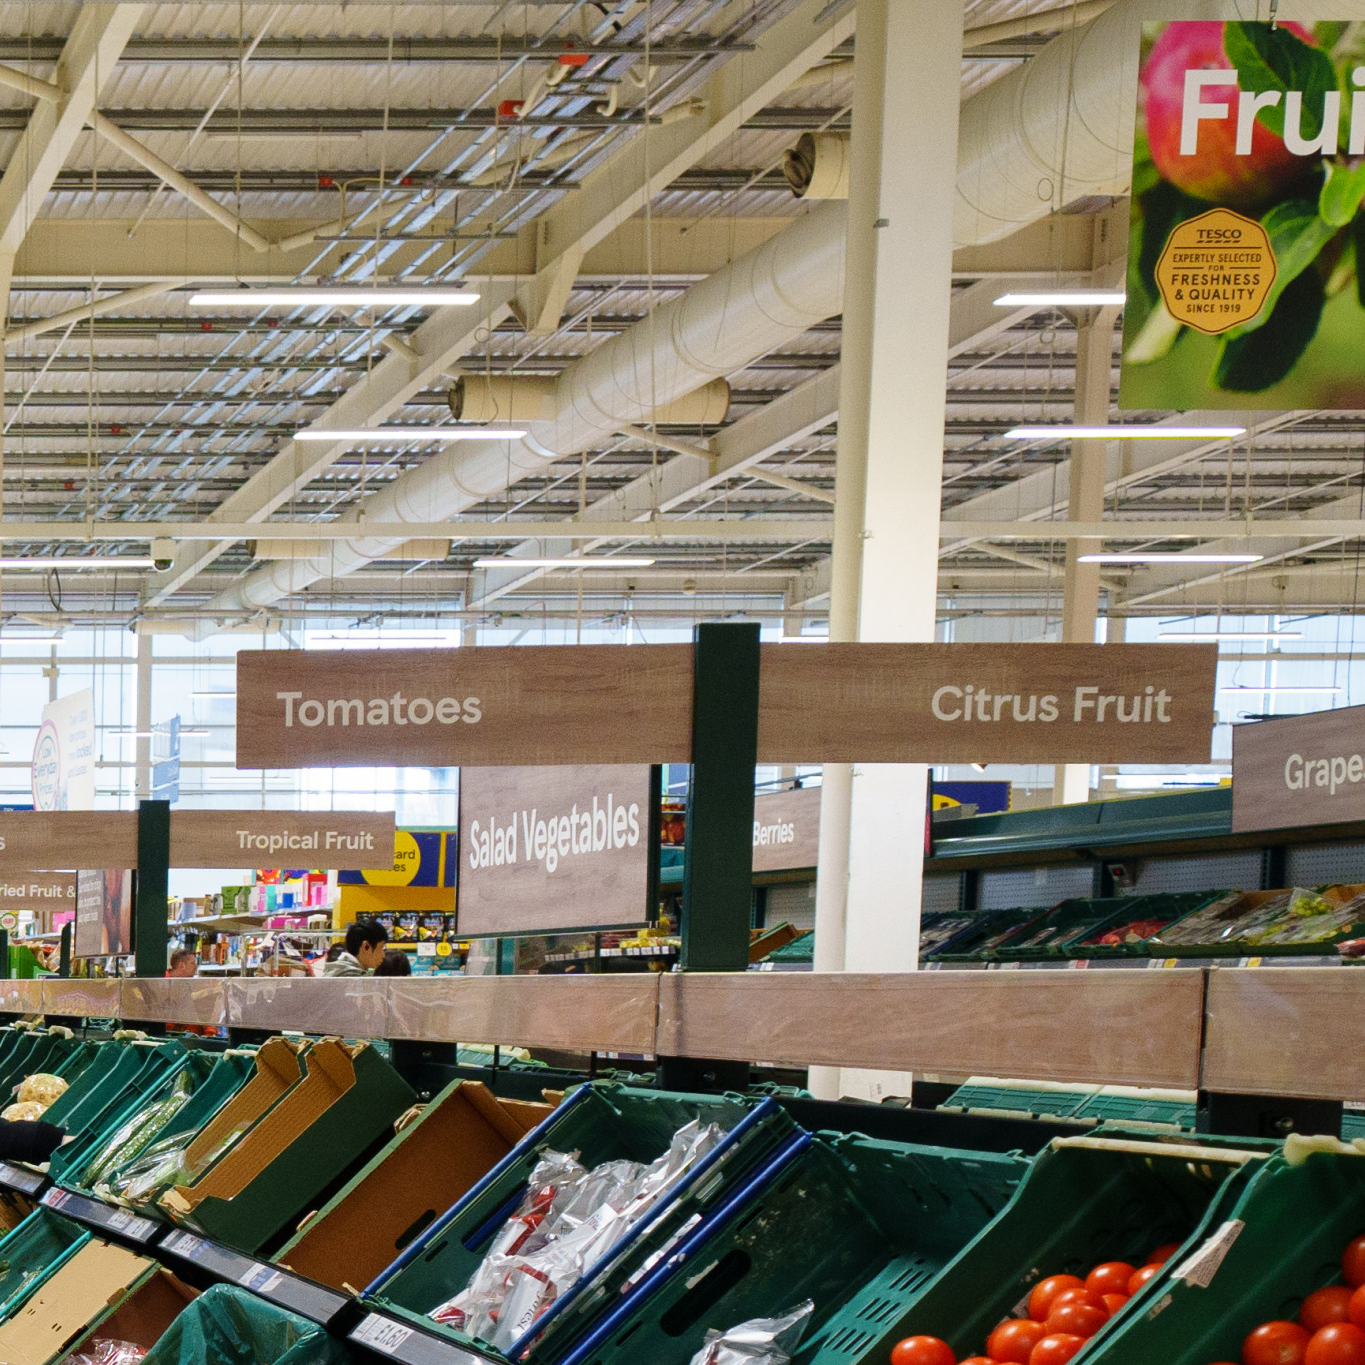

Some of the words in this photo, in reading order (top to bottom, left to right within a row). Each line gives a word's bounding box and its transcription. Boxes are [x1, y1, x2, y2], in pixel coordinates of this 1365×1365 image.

[1197, 229, 1242, 239] TESCO
[1172, 253, 1215, 263] EXPERTLY
[1218, 253, 1262, 263] SELECTED
[1171, 274, 1260, 286] FRESHNESS
[1175, 289, 1184, 300] &
[1189, 289, 1255, 300] QUALITY
[1186, 304, 1215, 313] SINCE
[1219, 304, 1240, 313] 1919
[277, 691, 482, 727] Tomatoes
[931, 685, 1059, 723] Citrus
[1072, 685, 1173, 723] Fruit
[469, 812, 518, 870] Salad
[522, 793, 640, 873] Vegetables
[752, 818, 795, 846] Berries
[235, 830, 318, 853] Tropical
[325, 831, 374, 850] Fruit
[30, 884, 62, 897] Fruit
[66, 886, 76, 897] &
[374, 1324, 407, 1348] £1.60
